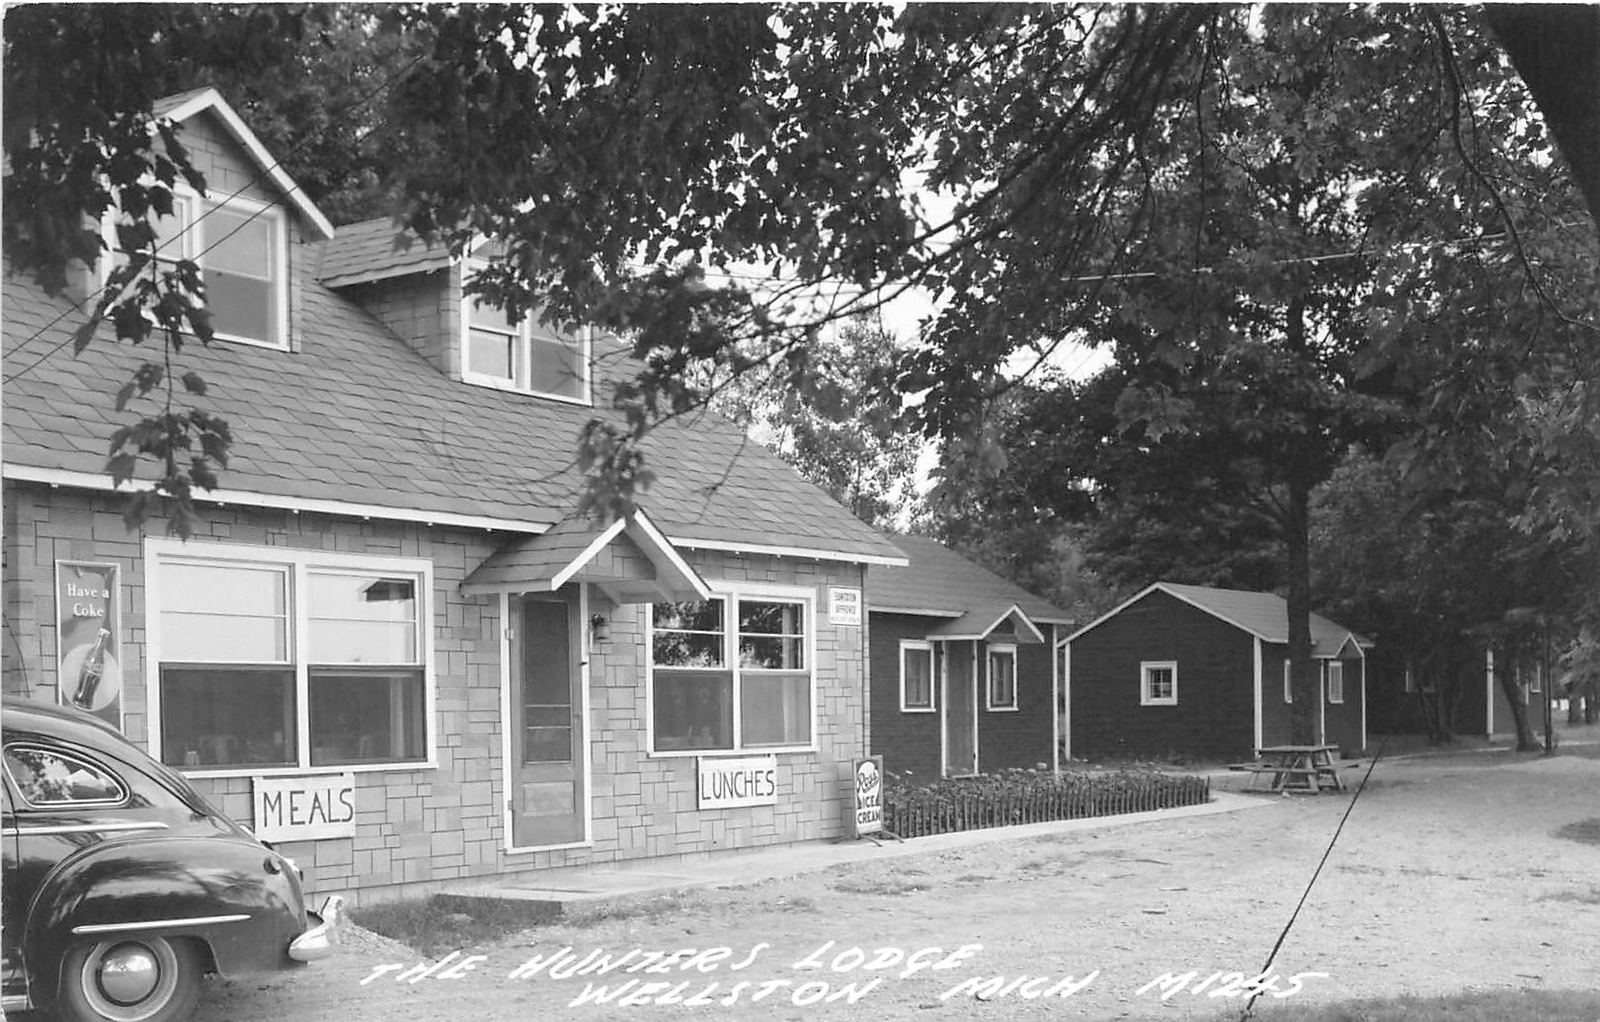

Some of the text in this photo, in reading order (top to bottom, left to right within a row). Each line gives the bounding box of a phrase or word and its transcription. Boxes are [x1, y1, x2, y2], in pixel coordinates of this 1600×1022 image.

[67, 583, 109, 599] Have a
[73, 603, 104, 617] Coke
[701, 770, 775, 801] LUNCHES
[263, 788, 354, 828] MEALS
[862, 796, 876, 809] ICE
[858, 810, 880, 824] CREAM
